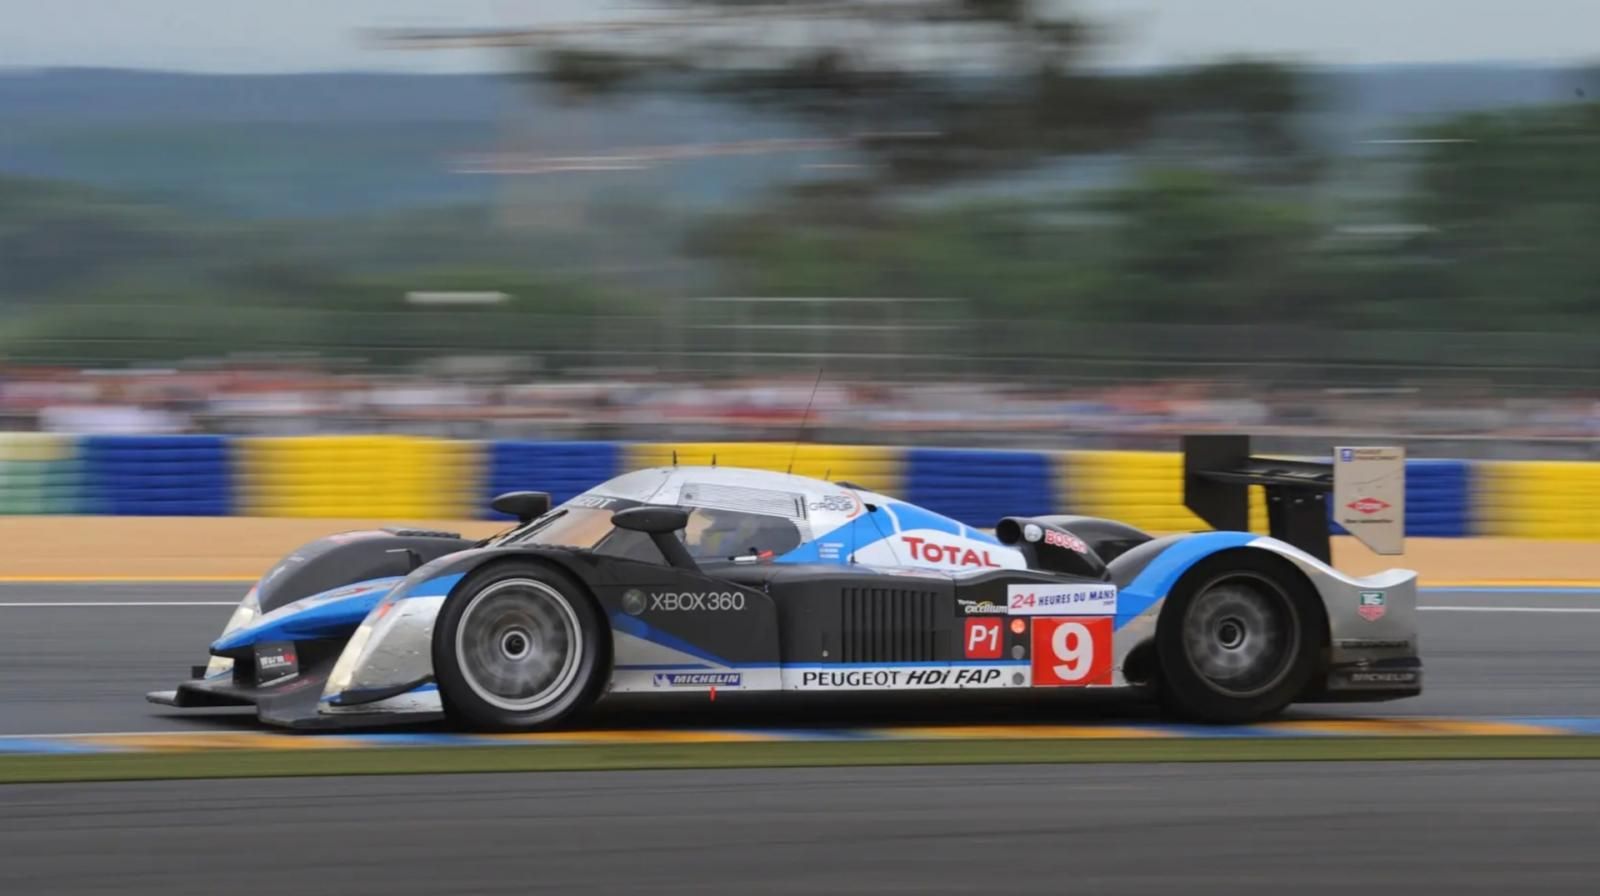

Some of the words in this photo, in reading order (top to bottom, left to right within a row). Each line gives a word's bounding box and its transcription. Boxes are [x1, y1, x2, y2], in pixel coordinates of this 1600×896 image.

[809, 502, 853, 511] GROUP
[1010, 593, 1036, 609] 24
[1038, 593, 1071, 607] HEURES
[1073, 591, 1086, 603] DU
[1089, 589, 1115, 601] MANS
[967, 624, 999, 652] P1
[1051, 621, 1095, 682] 9
[673, 673, 740, 684] MICHELIN
[802, 670, 900, 687] PEUGEOT
[954, 668, 1001, 685] FAP
